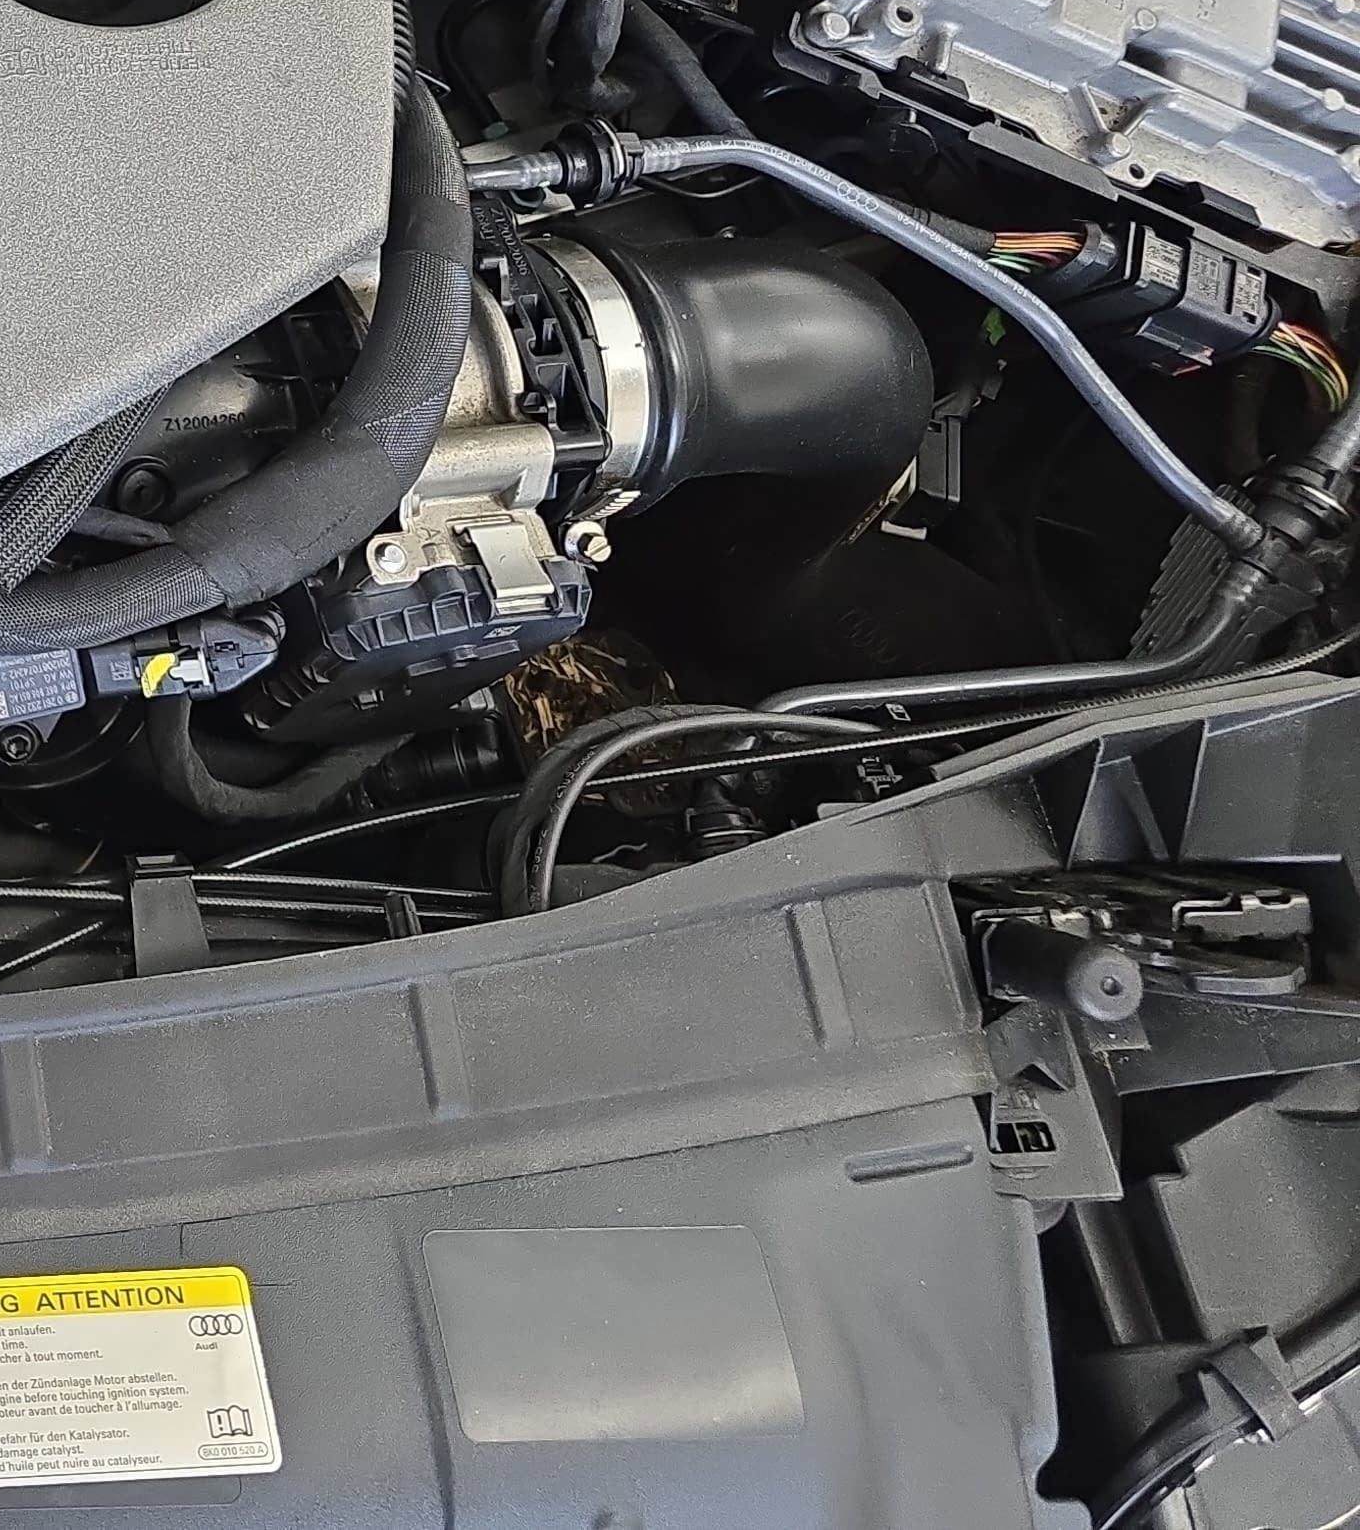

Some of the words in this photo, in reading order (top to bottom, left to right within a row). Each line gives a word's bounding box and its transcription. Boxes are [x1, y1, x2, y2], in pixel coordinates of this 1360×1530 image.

[36, 1285, 185, 1312] ATTENTION
[8, 1325, 55, 1336] anlaufen.
[2, 1339, 28, 1350] time.
[195, 1342, 218, 1351] Audi
[25, 1351, 31, 1362] à
[34, 1351, 53, 1361] tout
[57, 1349, 103, 1360] moment.
[12, 1379, 28, 1390] der
[30, 1376, 92, 1390] Zündanlage
[94, 1375, 126, 1386] Motor
[129, 1372, 177, 1384] abstellen.
[25, 1391, 57, 1403] before
[60, 1389, 104, 1403] touching
[107, 1386, 147, 1400] ignition
[149, 1385, 189, 1398] system.
[28, 1405, 56, 1416] avant
[59, 1404, 72, 1414] de
[75, 1402, 114, 1414] toucher
[117, 1401, 123, 1412] à
[30, 1431, 44, 1443] für
[47, 1430, 67, 1441] den
[69, 1427, 130, 1443] Katalysator.
[41, 1444, 84, 1457] catalyst.
[221, 1447, 238, 1456] 010
[36, 1459, 59, 1471] peut
[62, 1457, 89, 1468] nuire
[92, 1458, 105, 1467] au
[107, 1454, 162, 1468] catalyseur.
